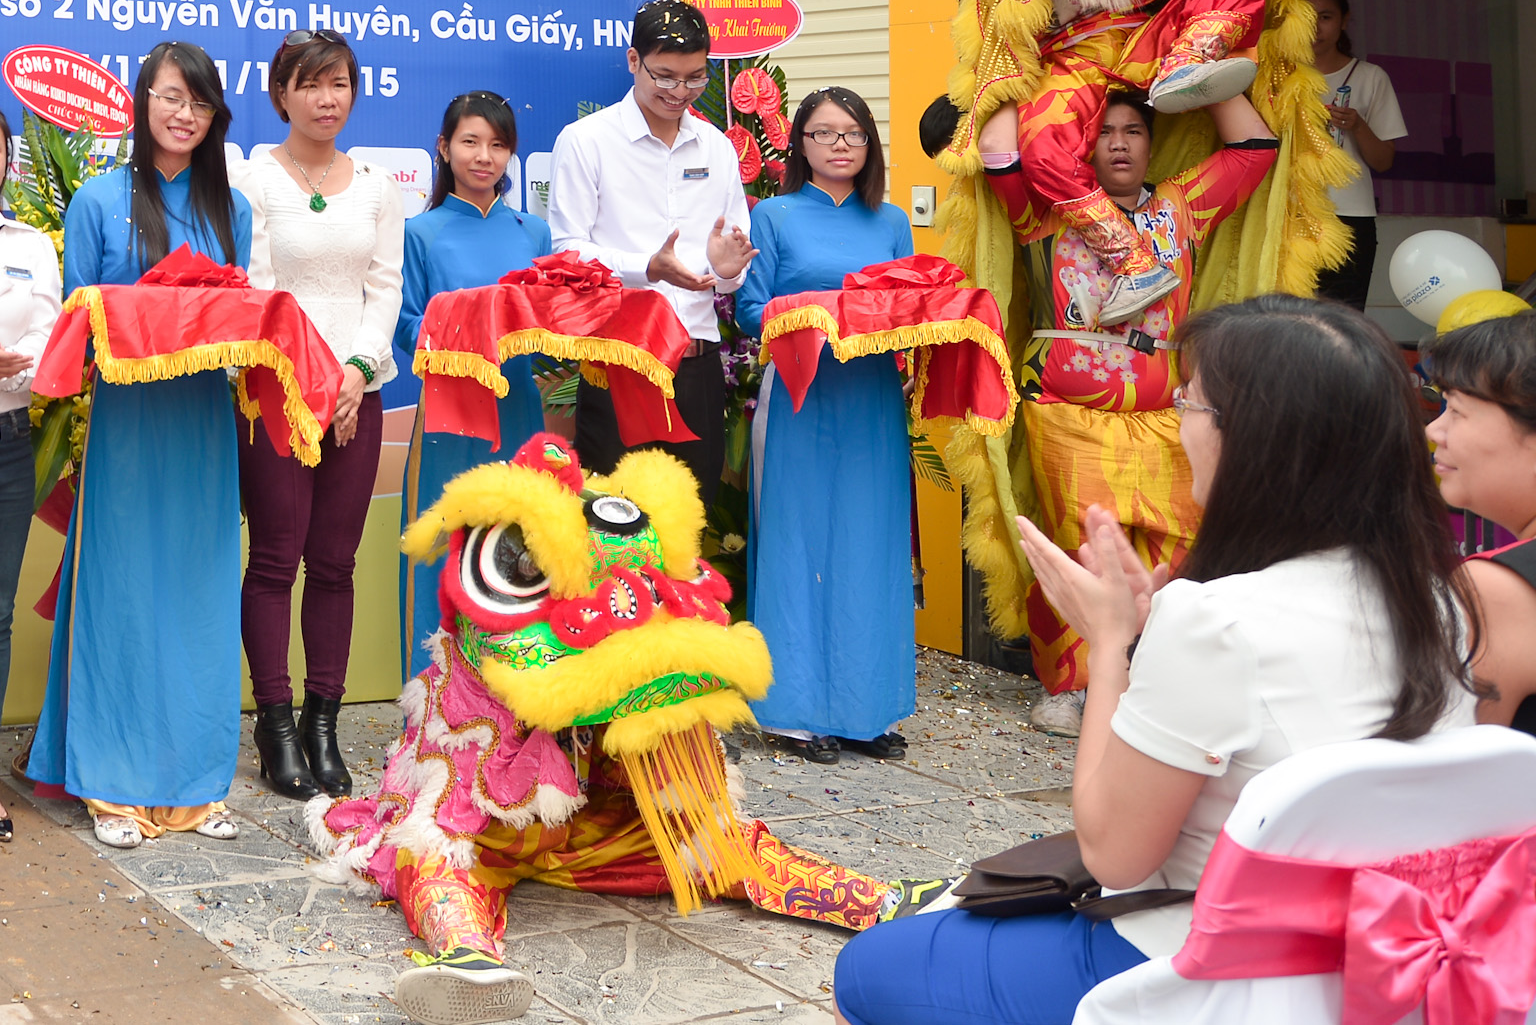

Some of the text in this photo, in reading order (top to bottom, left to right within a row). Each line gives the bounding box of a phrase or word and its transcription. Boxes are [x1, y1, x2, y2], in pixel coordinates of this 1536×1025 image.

[308, 4, 420, 42] Huyên,
[430, 2, 496, 42] Cầu
[506, 9, 583, 51] Giấy,
[722, 18, 749, 37] Khai
[15, 54, 52, 75] CÔNG
[54, 58, 71, 76] TY
[71, 63, 106, 93] THIÊN
[48, 103, 74, 119] CHÚC
